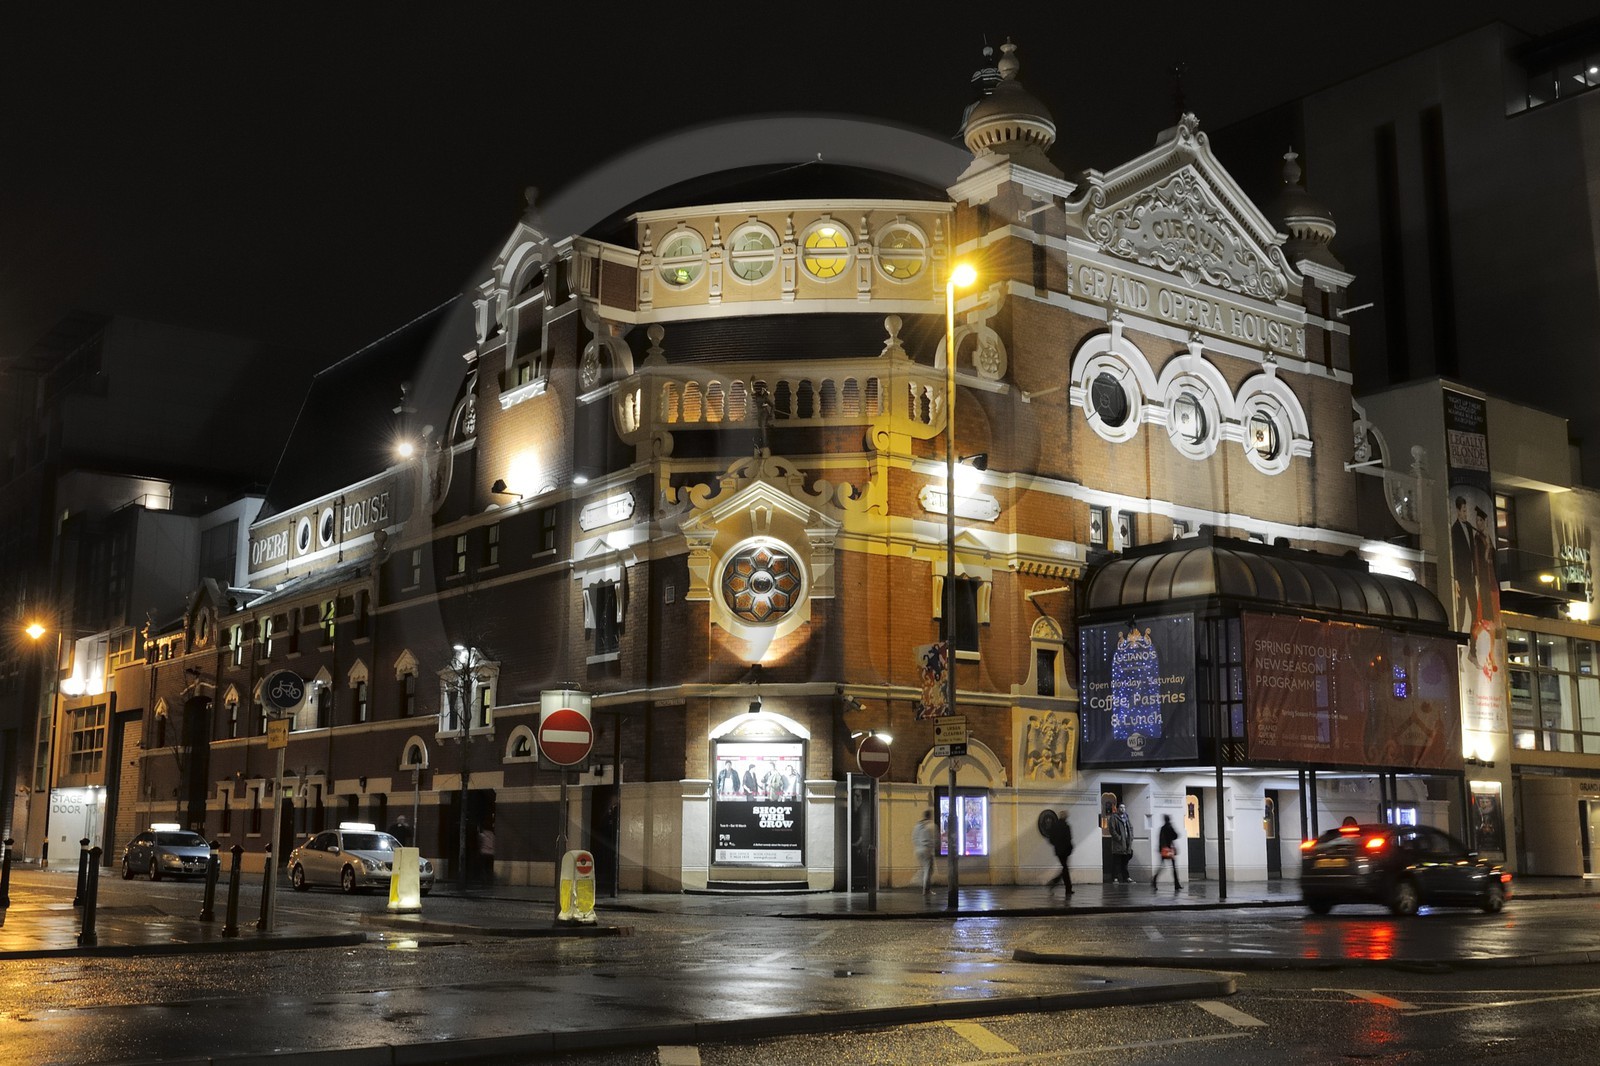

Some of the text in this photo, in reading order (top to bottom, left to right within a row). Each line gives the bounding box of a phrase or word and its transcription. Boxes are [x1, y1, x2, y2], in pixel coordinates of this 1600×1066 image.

[1152, 218, 1225, 262] CIRQUE
[1079, 263, 1294, 352] GRAND OPERA HOUSE
[1450, 433, 1484, 449] LEGALLY
[1451, 446, 1486, 459] BLONDE
[252, 492, 390, 565] OPERA HOUSE
[1561, 544, 1590, 563] GRAND
[1255, 640, 1338, 660] SPRING INTO OUR
[1255, 657, 1323, 675] NEW SEASON
[1089, 682, 1109, 692] Open
[1110, 678, 1142, 690] Monday
[1148, 674, 1185, 687] Saturday
[1256, 674, 1323, 691] PROGRAMME
[1133, 690, 1186, 706] Pastries
[1111, 711, 1162, 727] & Lunch
[1580, 782, 1598, 791] GRAND
[52, 794, 82, 803] STAGE
[53, 805, 81, 814] DOOR
[753, 806, 792, 814] SHOOT
[759, 820, 794, 828] CROW
